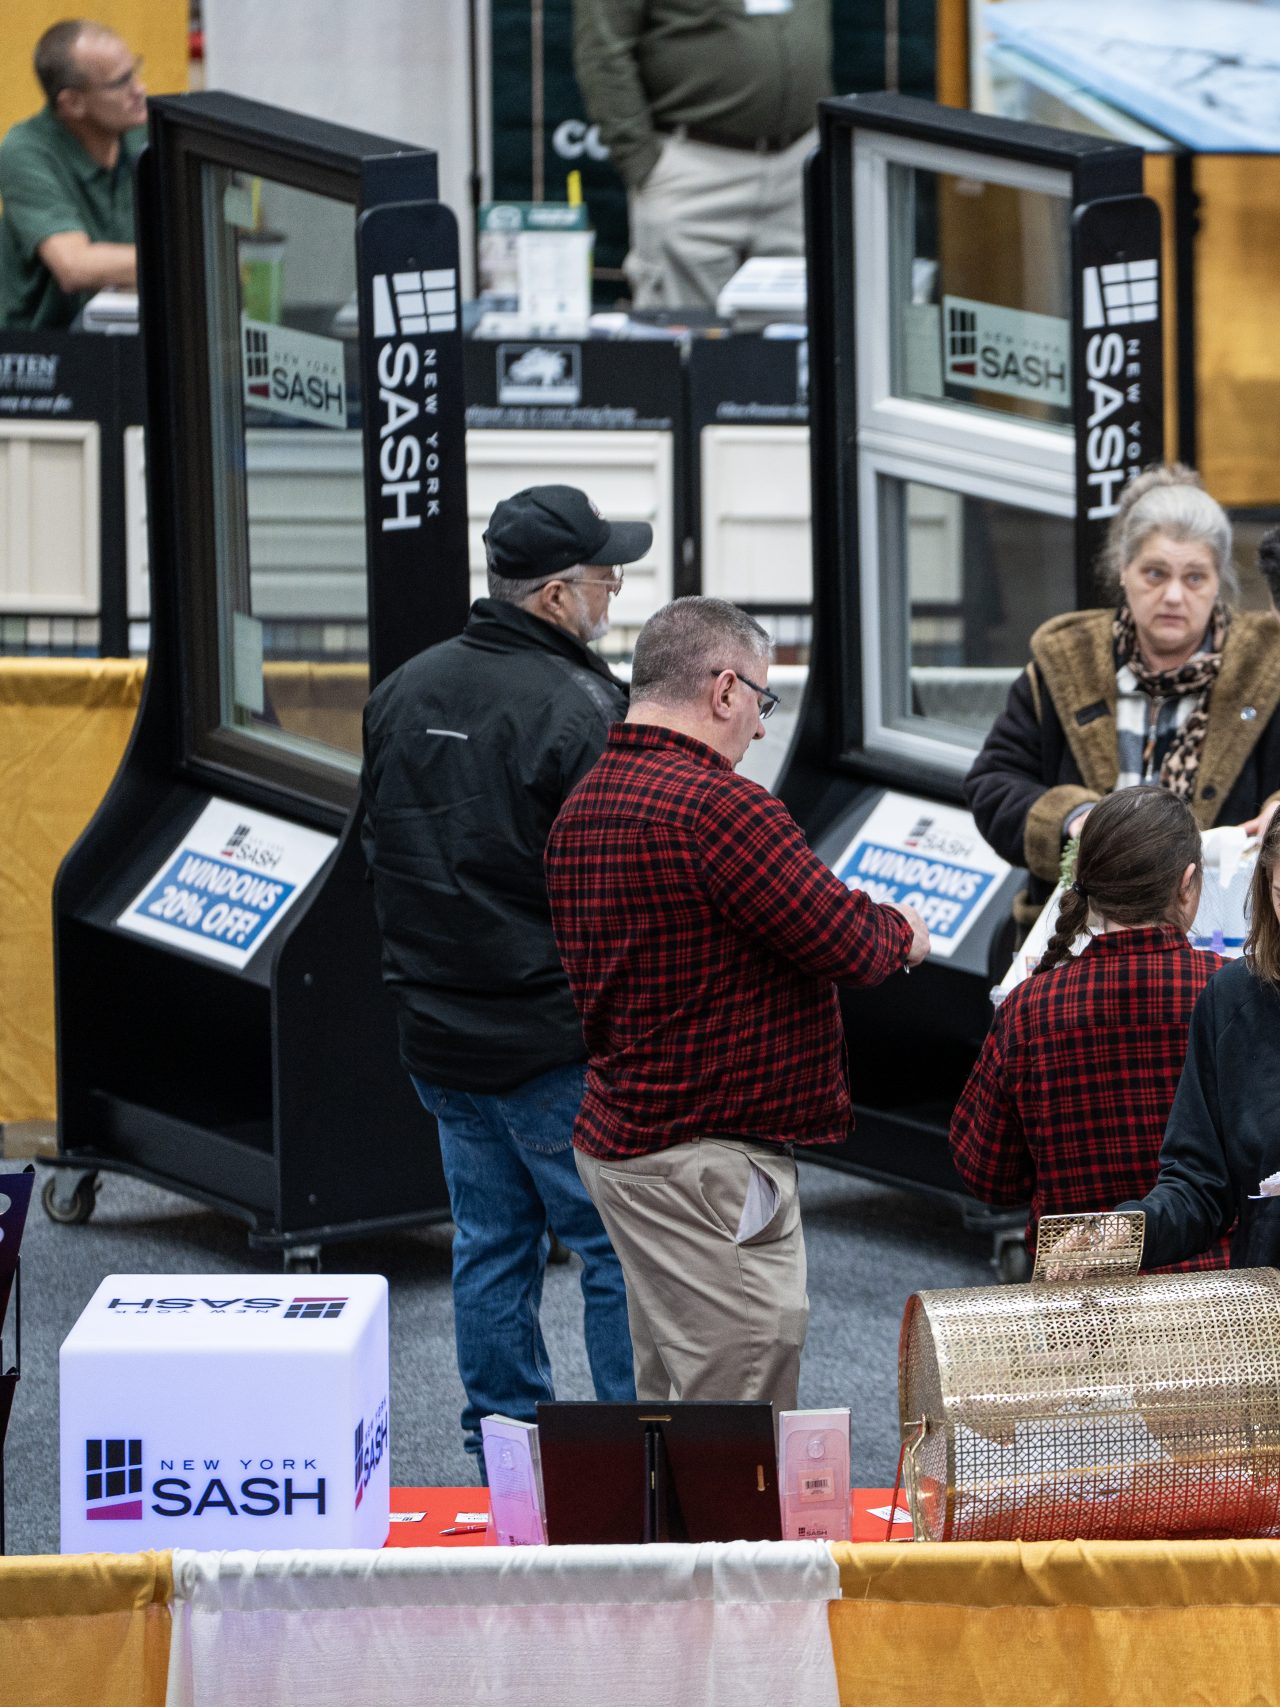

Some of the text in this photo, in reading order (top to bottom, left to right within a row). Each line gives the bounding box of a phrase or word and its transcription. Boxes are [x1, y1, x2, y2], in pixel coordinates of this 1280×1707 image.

[272, 367, 343, 416] SASH
[981, 346, 1066, 393] SASH
[423, 349, 441, 517] NEW YORK
[1086, 332, 1126, 521] SASH
[1125, 338, 1142, 480] NEW YOR
[377, 342, 422, 532] SASH
[177, 855, 284, 911] WINDOWS
[236, 846, 281, 869] SASH
[858, 846, 984, 900] WINDOWS
[148, 885, 261, 944] 20% OFF!
[107, 1298, 284, 1309] SASH
[160, 1459, 318, 1471] NEW YORK
[363, 1409, 388, 1488] SASH
[151, 1477, 326, 1517] SASH
[806, 1529, 828, 1537] SASH
